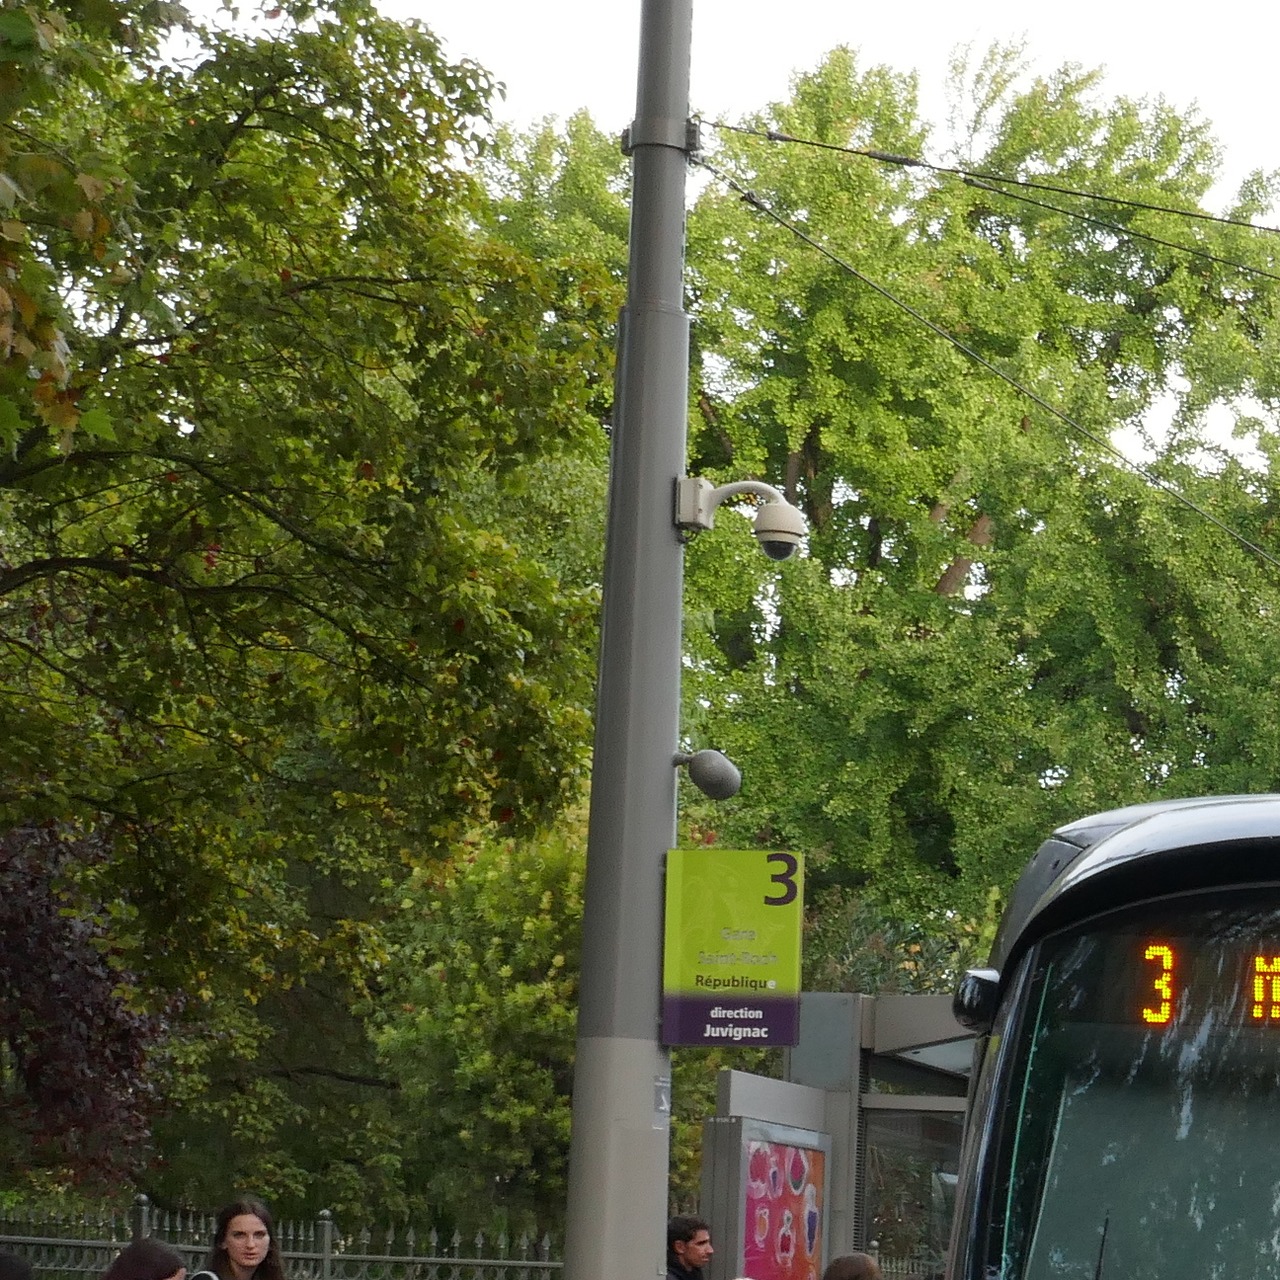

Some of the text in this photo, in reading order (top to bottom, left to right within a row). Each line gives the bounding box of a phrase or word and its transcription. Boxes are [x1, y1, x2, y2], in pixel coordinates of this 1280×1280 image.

[763, 852, 798, 907] 3
[695, 974, 777, 990] République
[1142, 945, 1174, 1023] 3
[709, 1006, 763, 1020] direction
[703, 1023, 769, 1041] Juvignac
